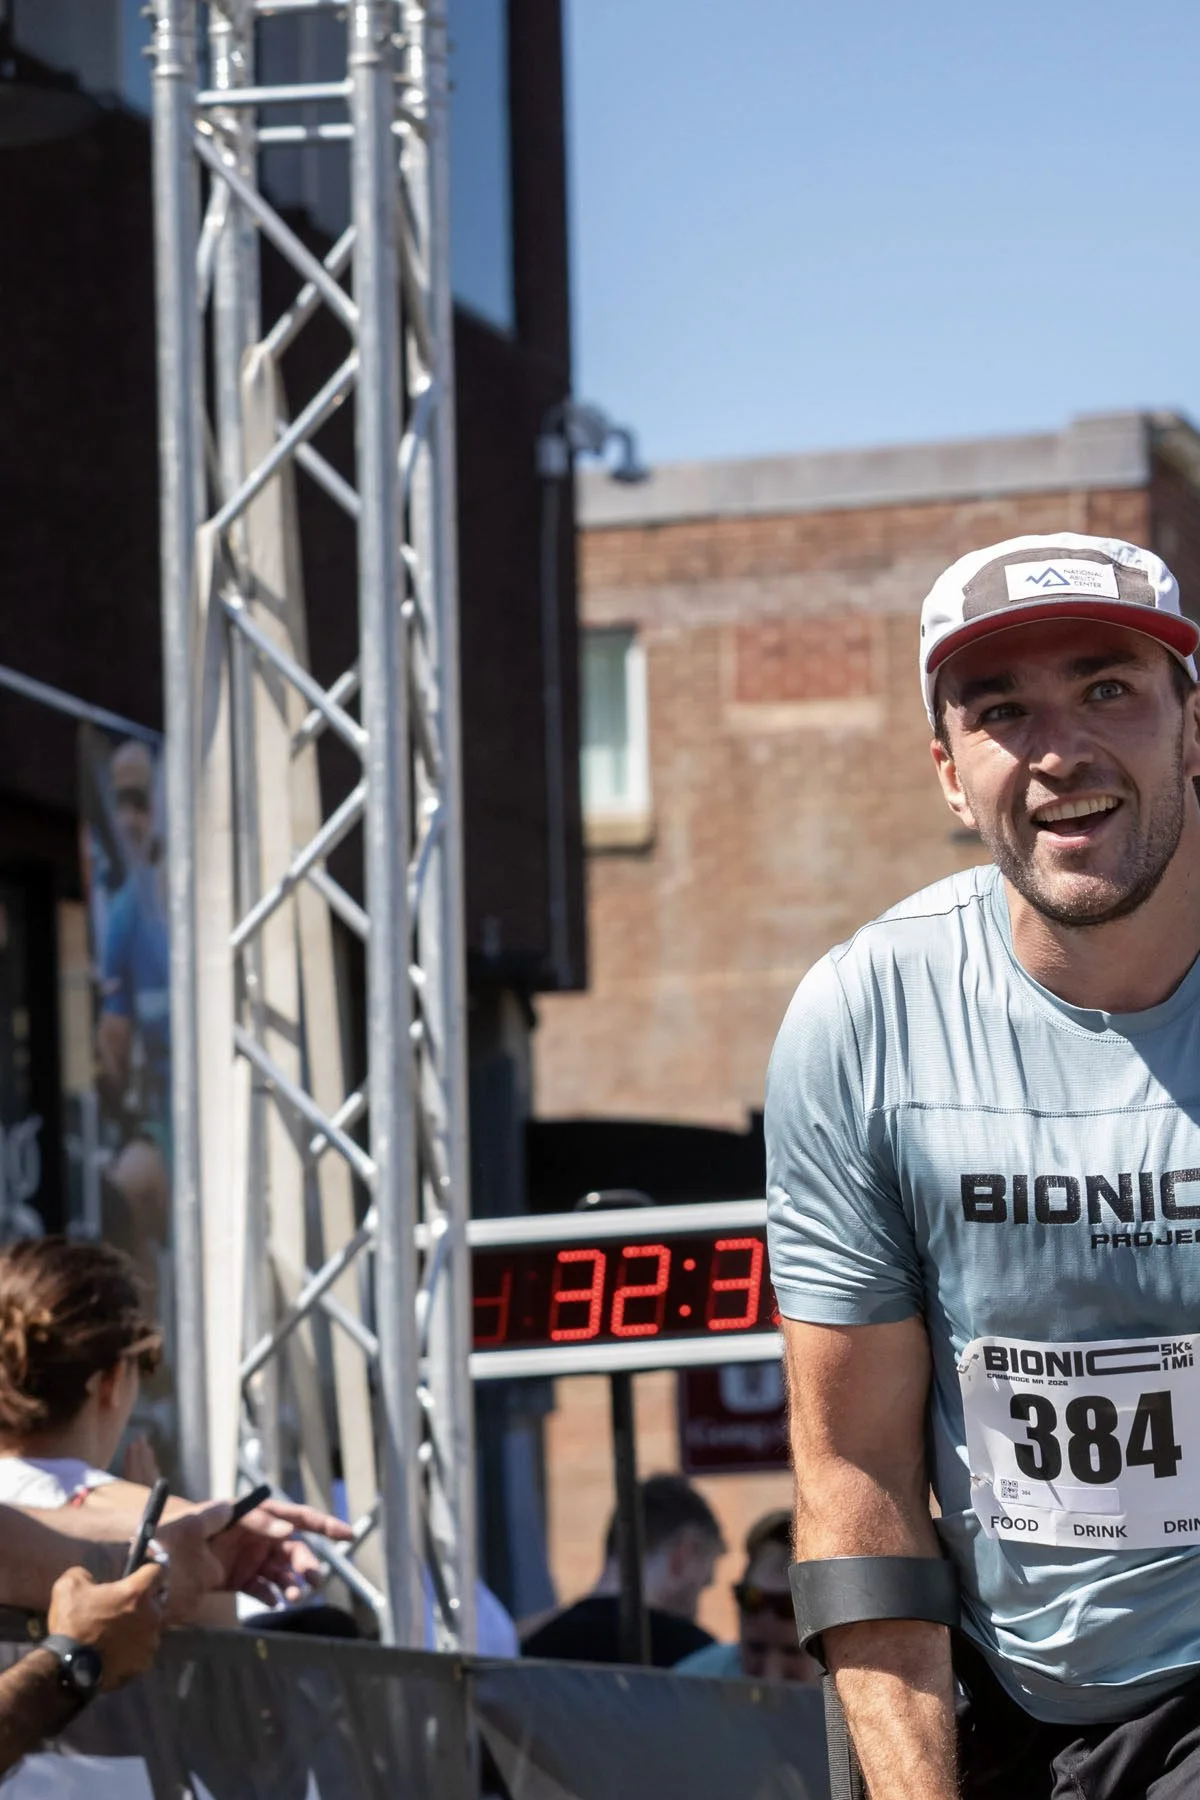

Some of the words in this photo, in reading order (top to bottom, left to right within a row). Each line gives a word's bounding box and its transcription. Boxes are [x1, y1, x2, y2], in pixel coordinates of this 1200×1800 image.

[551, 1238, 783, 1341] 32:3
[983, 1343, 1161, 1378] BIONIC
[987, 1373, 1030, 1383] CAMBRIDGE
[1010, 1390, 1182, 1484] 384
[990, 1515, 1039, 1532] FOOD
[1073, 1524, 1128, 1538] DRINK
